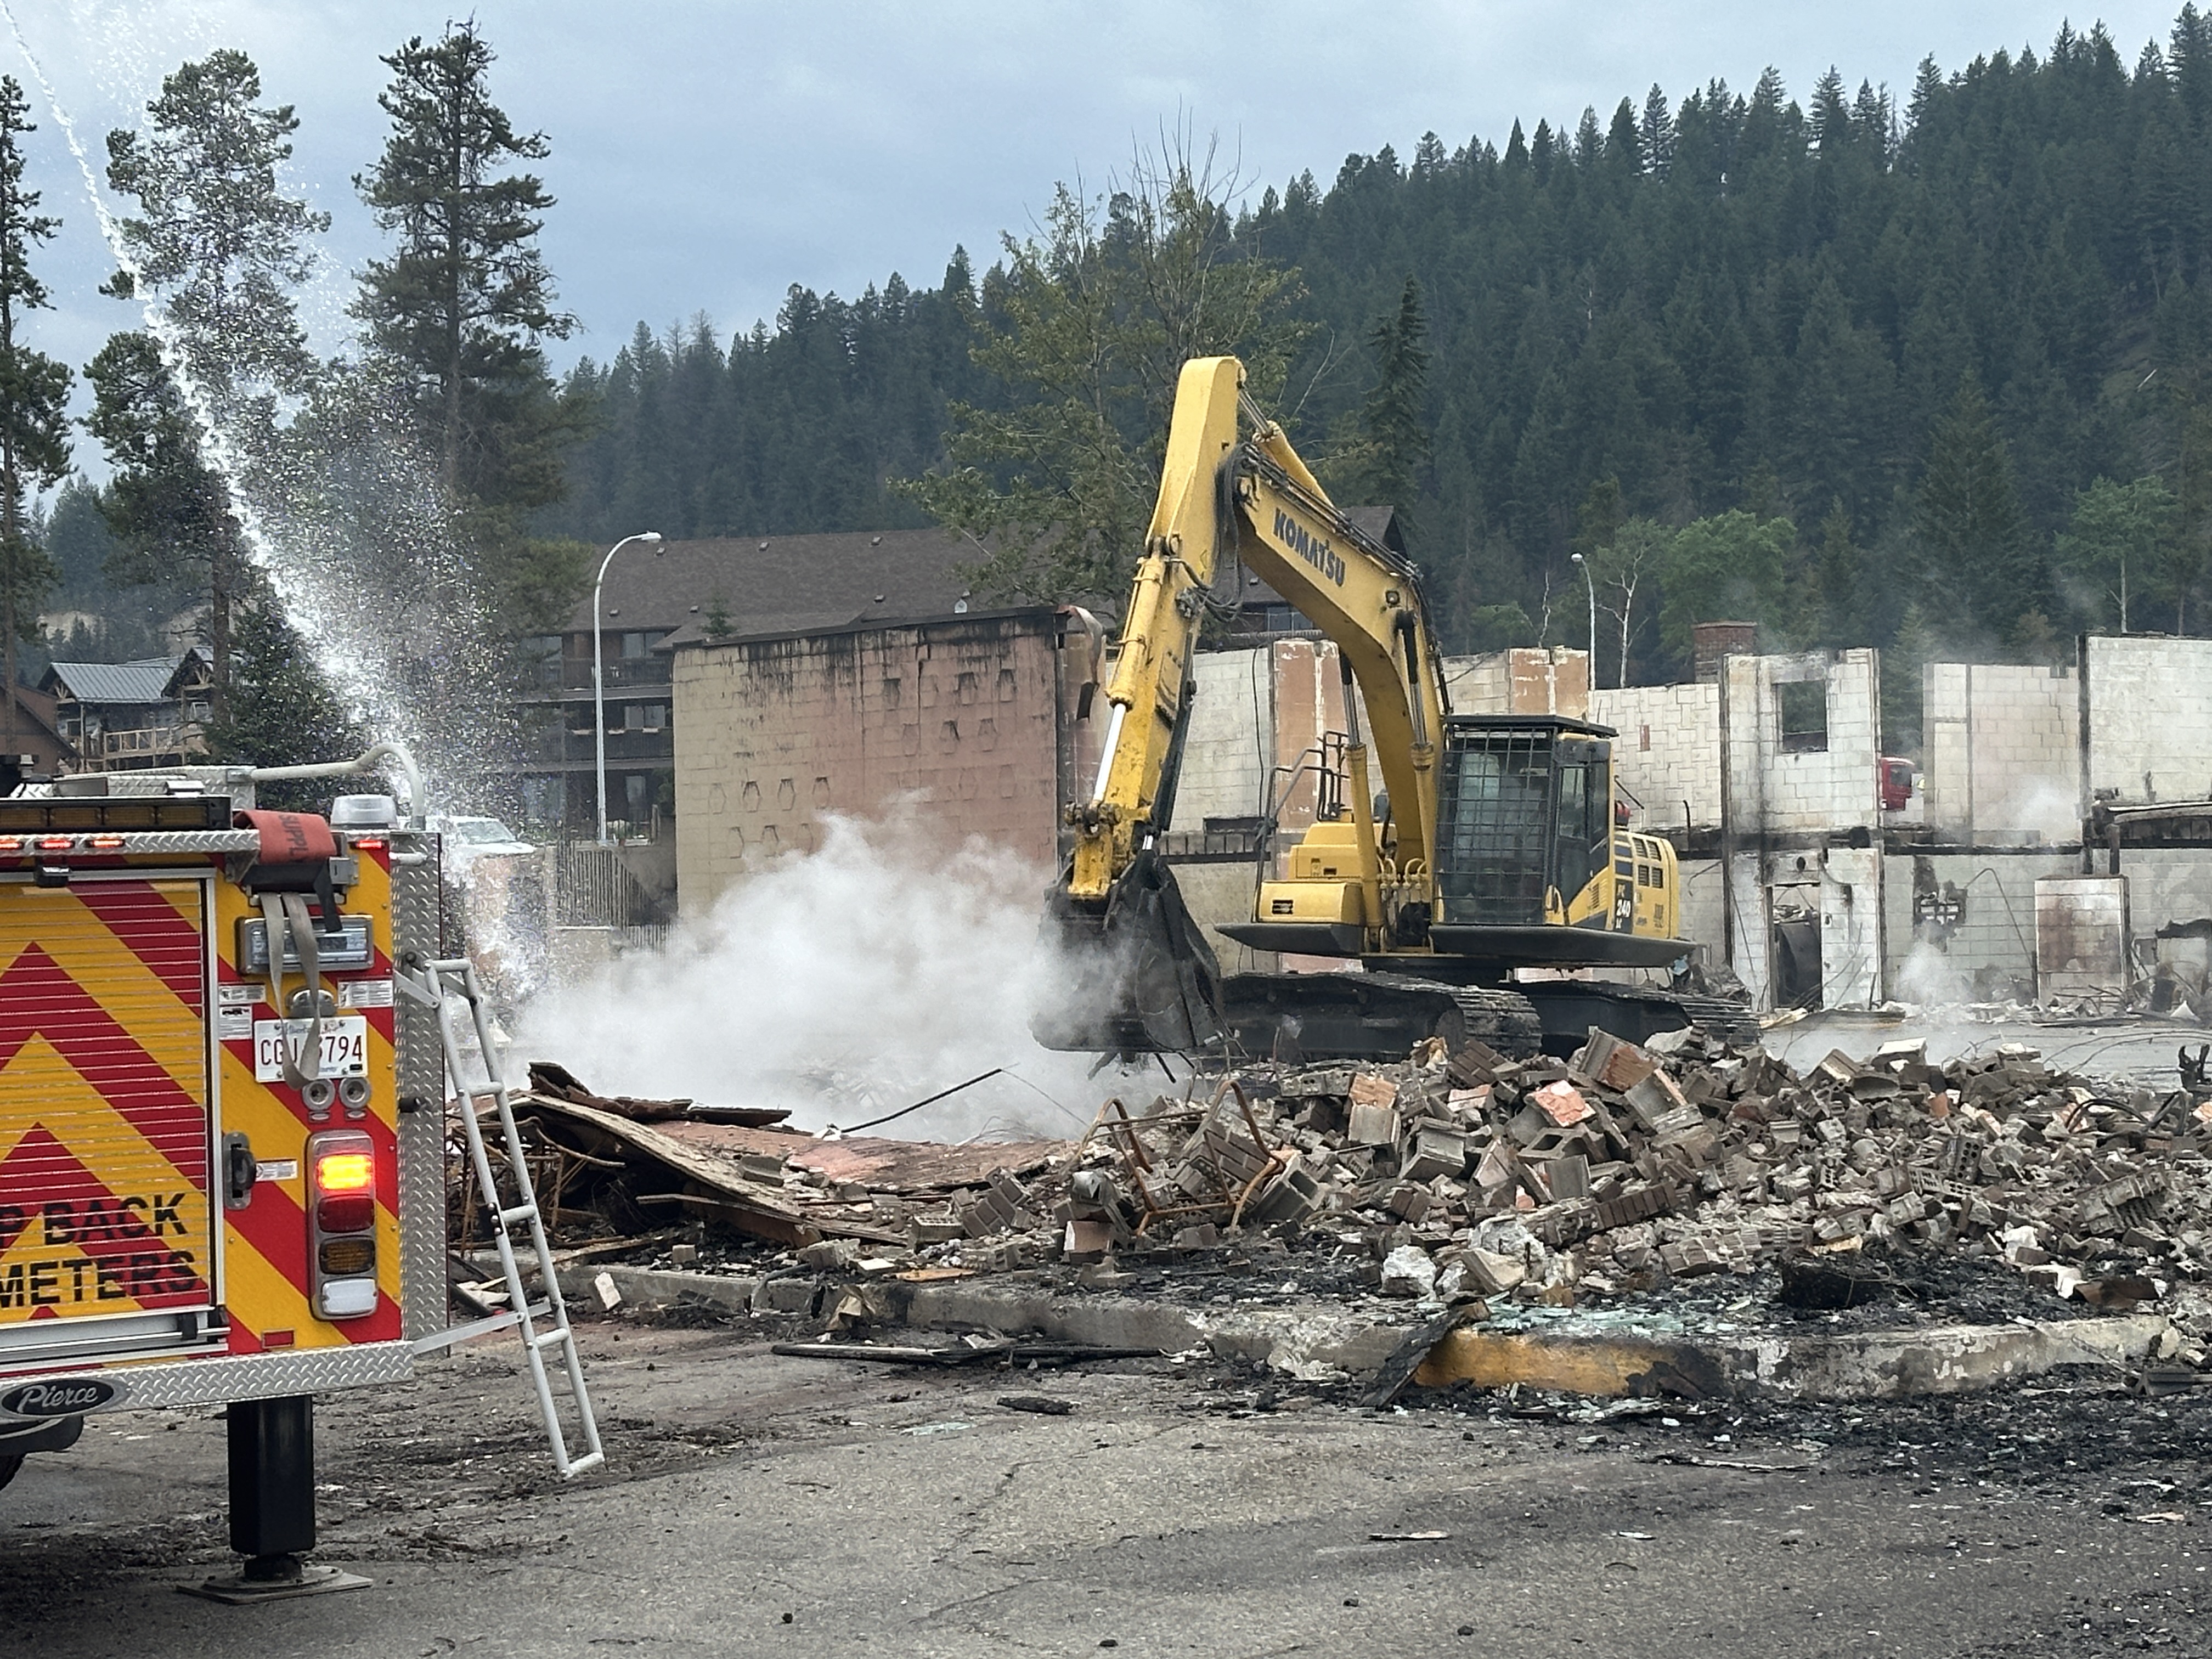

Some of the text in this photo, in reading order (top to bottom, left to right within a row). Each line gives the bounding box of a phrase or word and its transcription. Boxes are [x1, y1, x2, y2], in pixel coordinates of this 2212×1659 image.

[1273, 506, 1346, 588] KOMATSU
[278, 815, 308, 856] SUPPL
[1616, 899, 1631, 918] 240
[43, 1193, 188, 1245] BACK
[0, 1250, 196, 1308] METERS
[17, 1385, 98, 1413] Pierce
